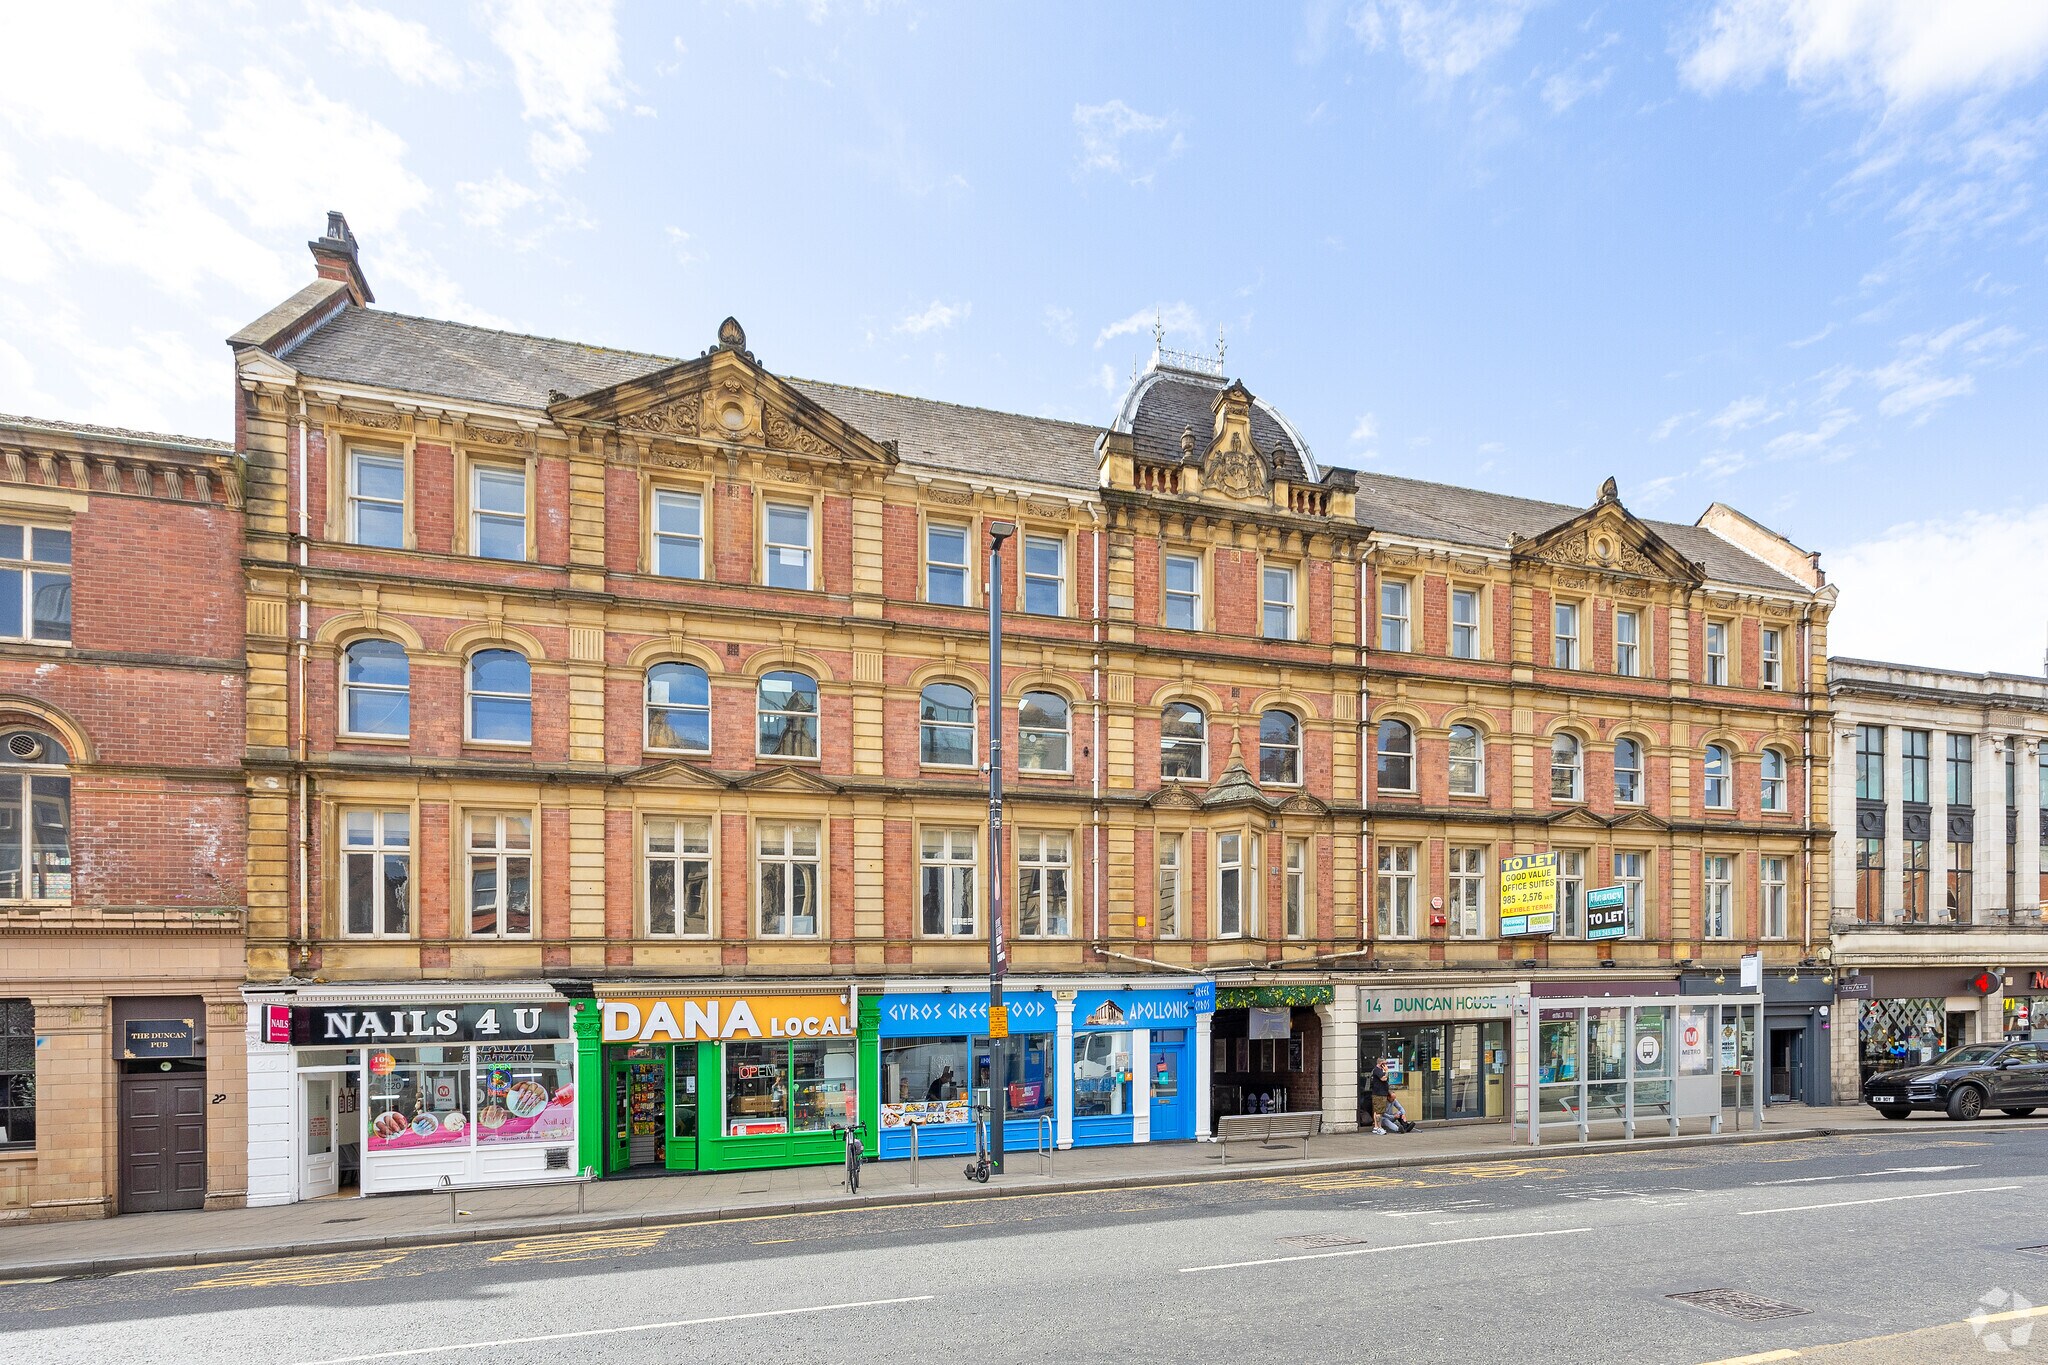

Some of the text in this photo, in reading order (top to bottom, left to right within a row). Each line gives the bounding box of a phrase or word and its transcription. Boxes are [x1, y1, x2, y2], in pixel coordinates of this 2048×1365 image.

[1503, 853, 1555, 871] TO LET
[1505, 869, 1551, 882] GOOD VALUE
[1502, 879, 1555, 893] OFFICE SUITES
[1502, 895, 1516, 905] 985
[1522, 892, 1543, 903] 2,576
[1502, 903, 1553, 914] FLEXIBLE TERMS
[1589, 910, 1624, 925] TO LET
[1129, 1001, 1190, 1019] APOLLONIS
[1365, 998, 1382, 1013] 14
[1394, 997, 1452, 1013] DUNCAN
[1456, 995, 1497, 1010] HOUSE
[888, 1003, 942, 1021] GYROS
[947, 1002, 991, 1020] GREE
[271, 1018, 289, 1029] NAILS
[323, 1008, 543, 1038] NAILS 4 U
[604, 1000, 853, 1041] DANA LOCAL
[131, 1032, 150, 1040] THE
[257, 1060, 277, 1071] 20
[488, 1063, 511, 1071] OPEN
[740, 1065, 774, 1078] OPEN
